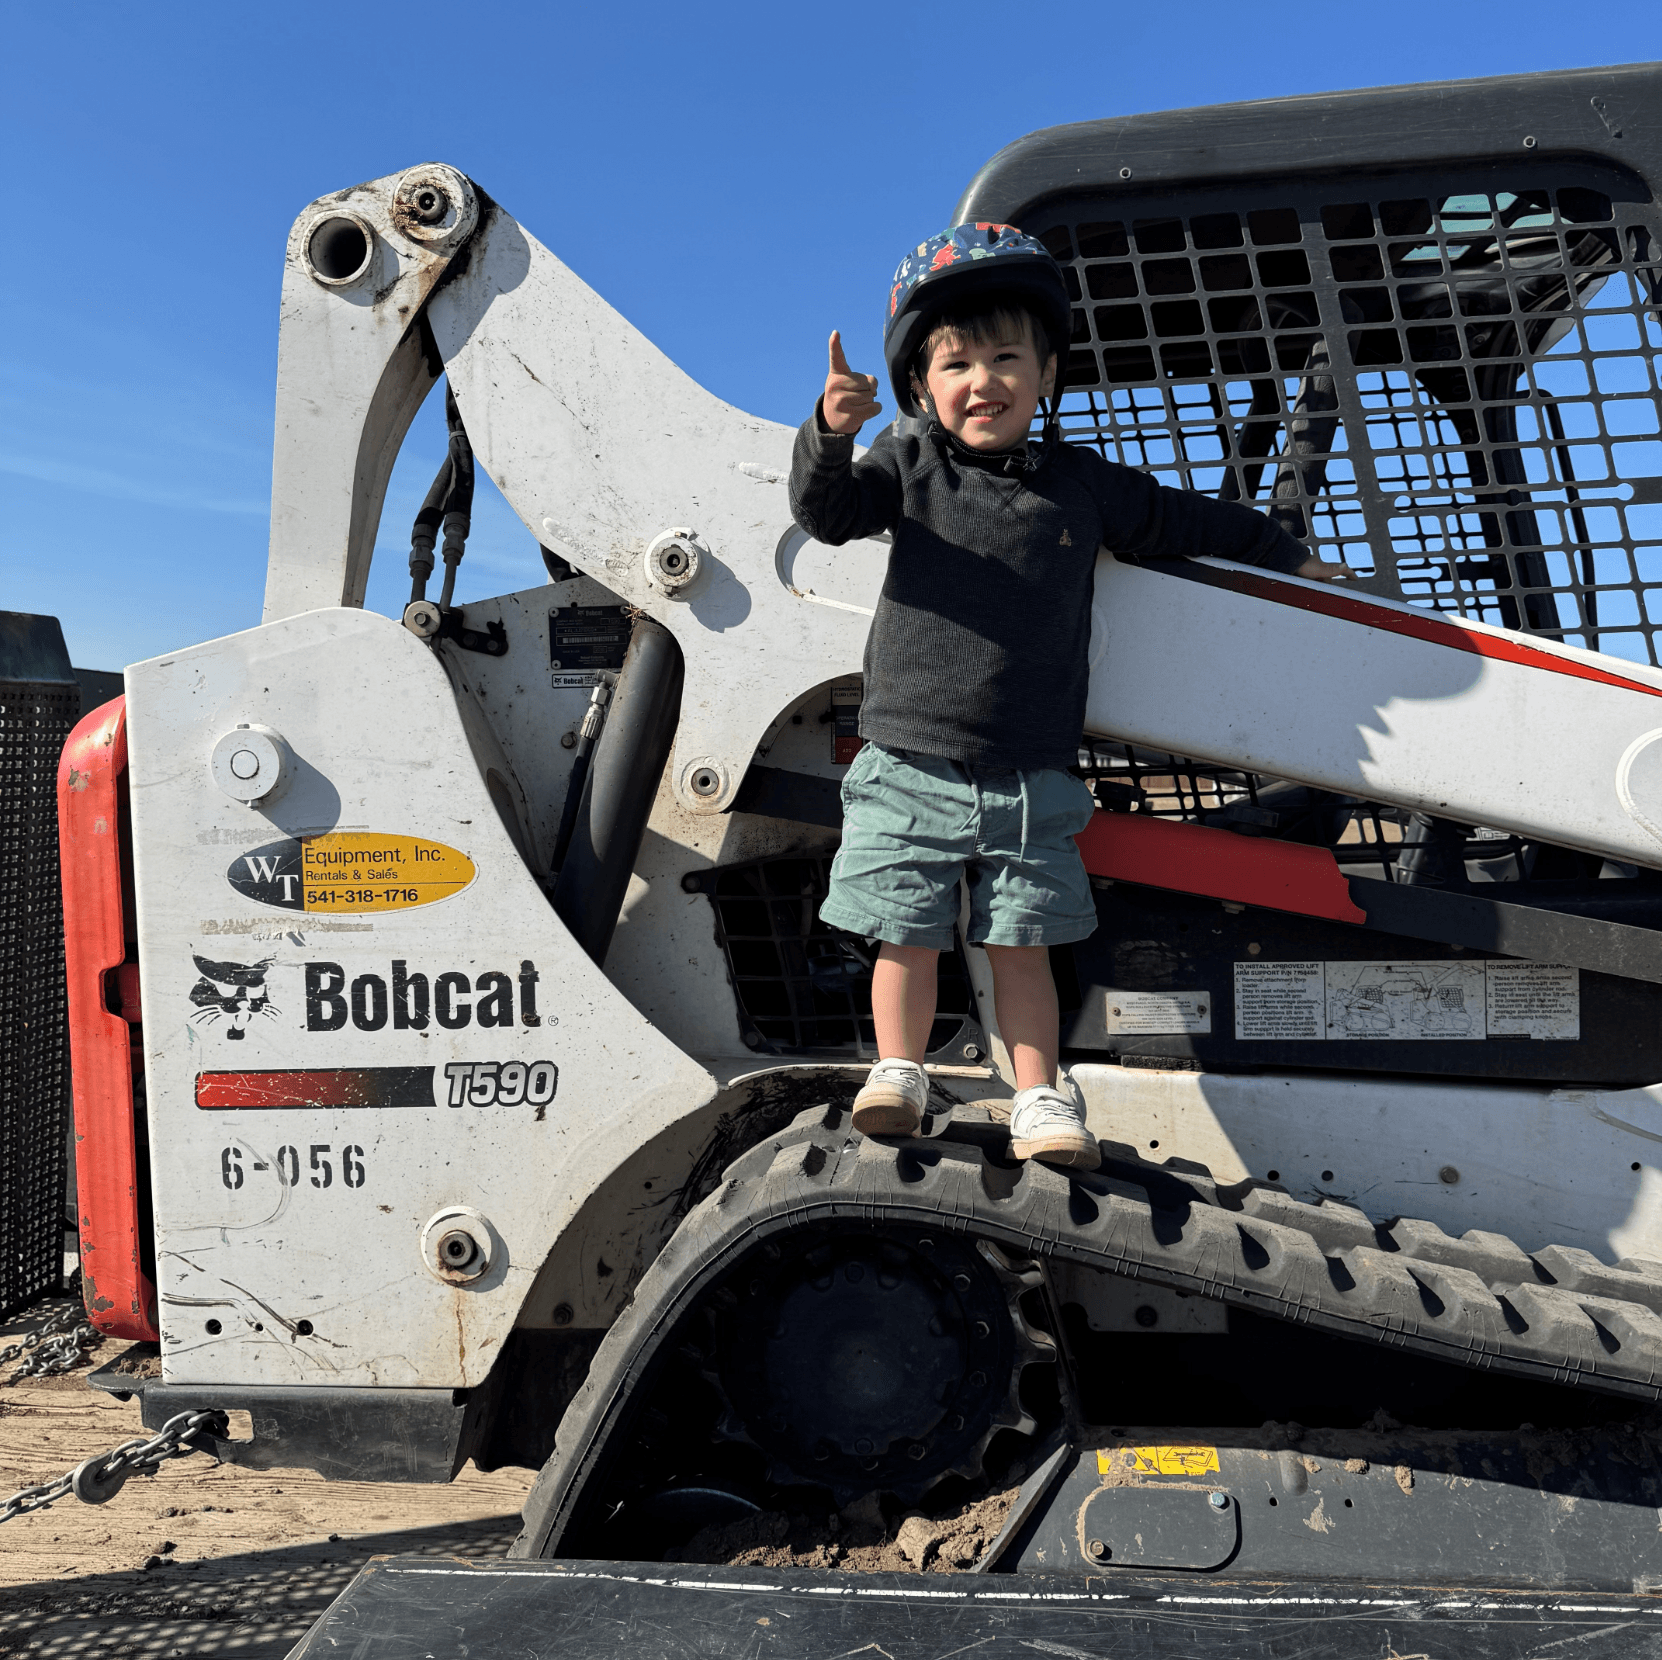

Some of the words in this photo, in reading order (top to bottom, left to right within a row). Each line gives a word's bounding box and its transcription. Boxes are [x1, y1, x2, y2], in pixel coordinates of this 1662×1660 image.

[304, 847, 408, 867] Equipment,
[414, 845, 446, 862] Inc.
[305, 870, 348, 881] Rentals
[353, 869, 361, 881] &
[367, 869, 398, 880] Sales
[307, 889, 419, 904] 541-318-1716
[305, 959, 541, 1032] Bobcat
[445, 1060, 559, 1107] T590
[221, 1145, 365, 1190] 6-056
